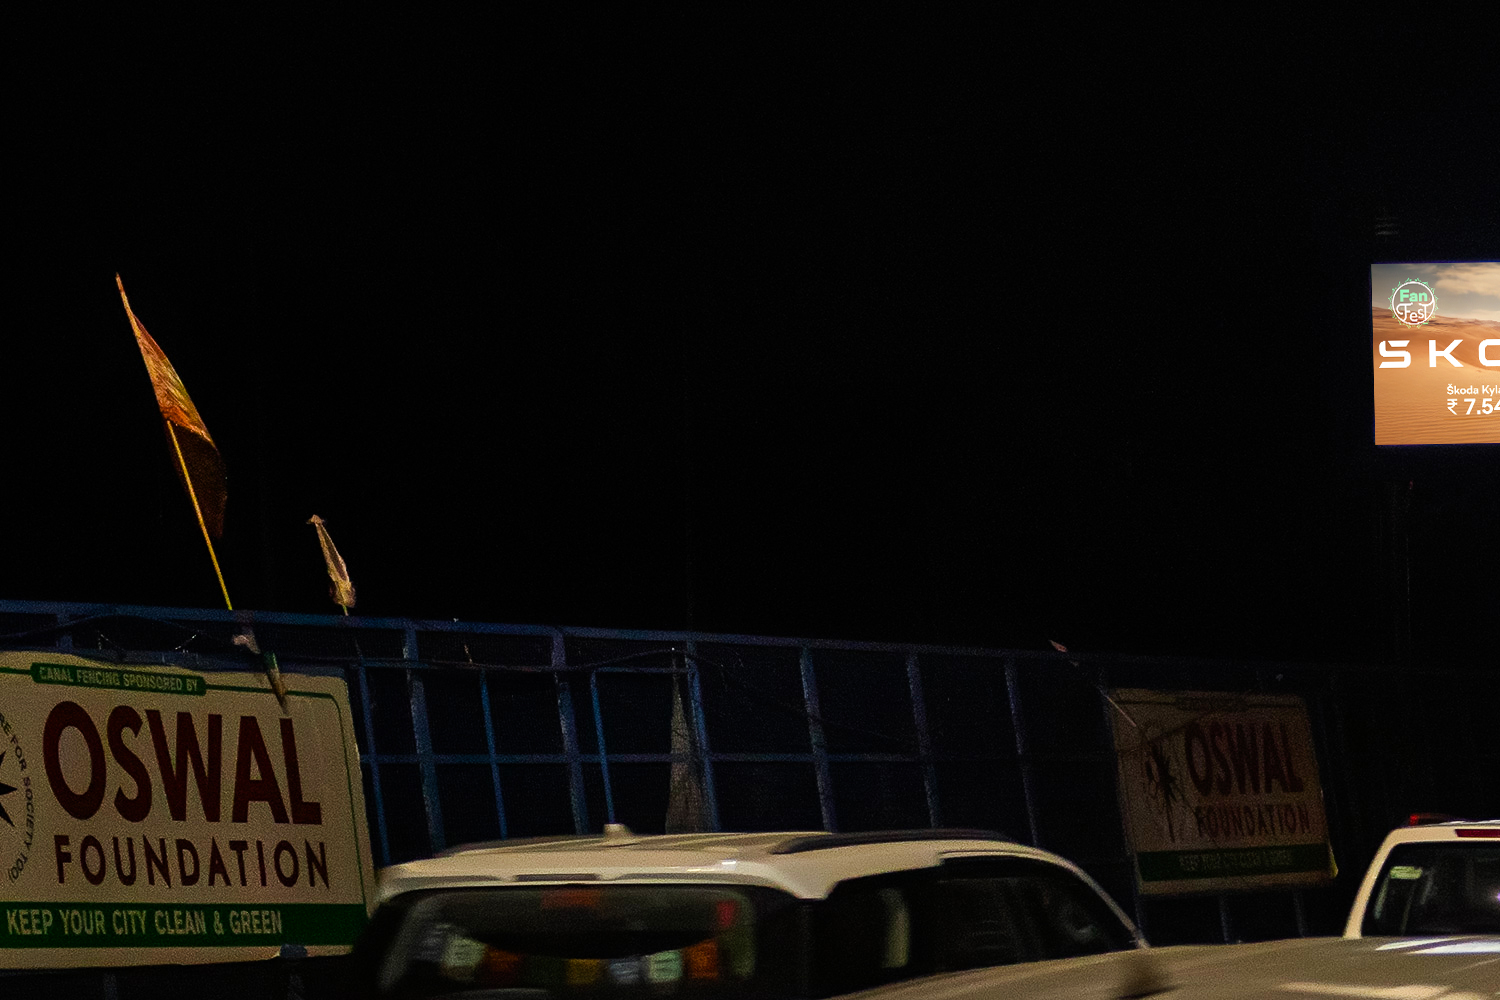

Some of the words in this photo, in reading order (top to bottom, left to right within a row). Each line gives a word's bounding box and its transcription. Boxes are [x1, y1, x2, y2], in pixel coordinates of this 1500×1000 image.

[1399, 289, 1428, 303] Fan
[1446, 383, 1479, 395] Škoda
[38, 666, 75, 683] CANAL
[76, 669, 121, 687] FENCING
[122, 673, 183, 691] SPONSORED
[185, 678, 199, 693] BY
[42, 700, 323, 826] OSWAL
[10, 735, 28, 771] FOR
[22, 777, 35, 852] SOCIETY
[53, 833, 330, 890] FOUNDATION
[6, 908, 53, 935] KEEP
[58, 908, 107, 935] YOUR
[111, 908, 147, 935] CITY
[154, 908, 207, 935] CLEAN
[212, 909, 225, 936] &
[228, 909, 283, 935] GREEN
